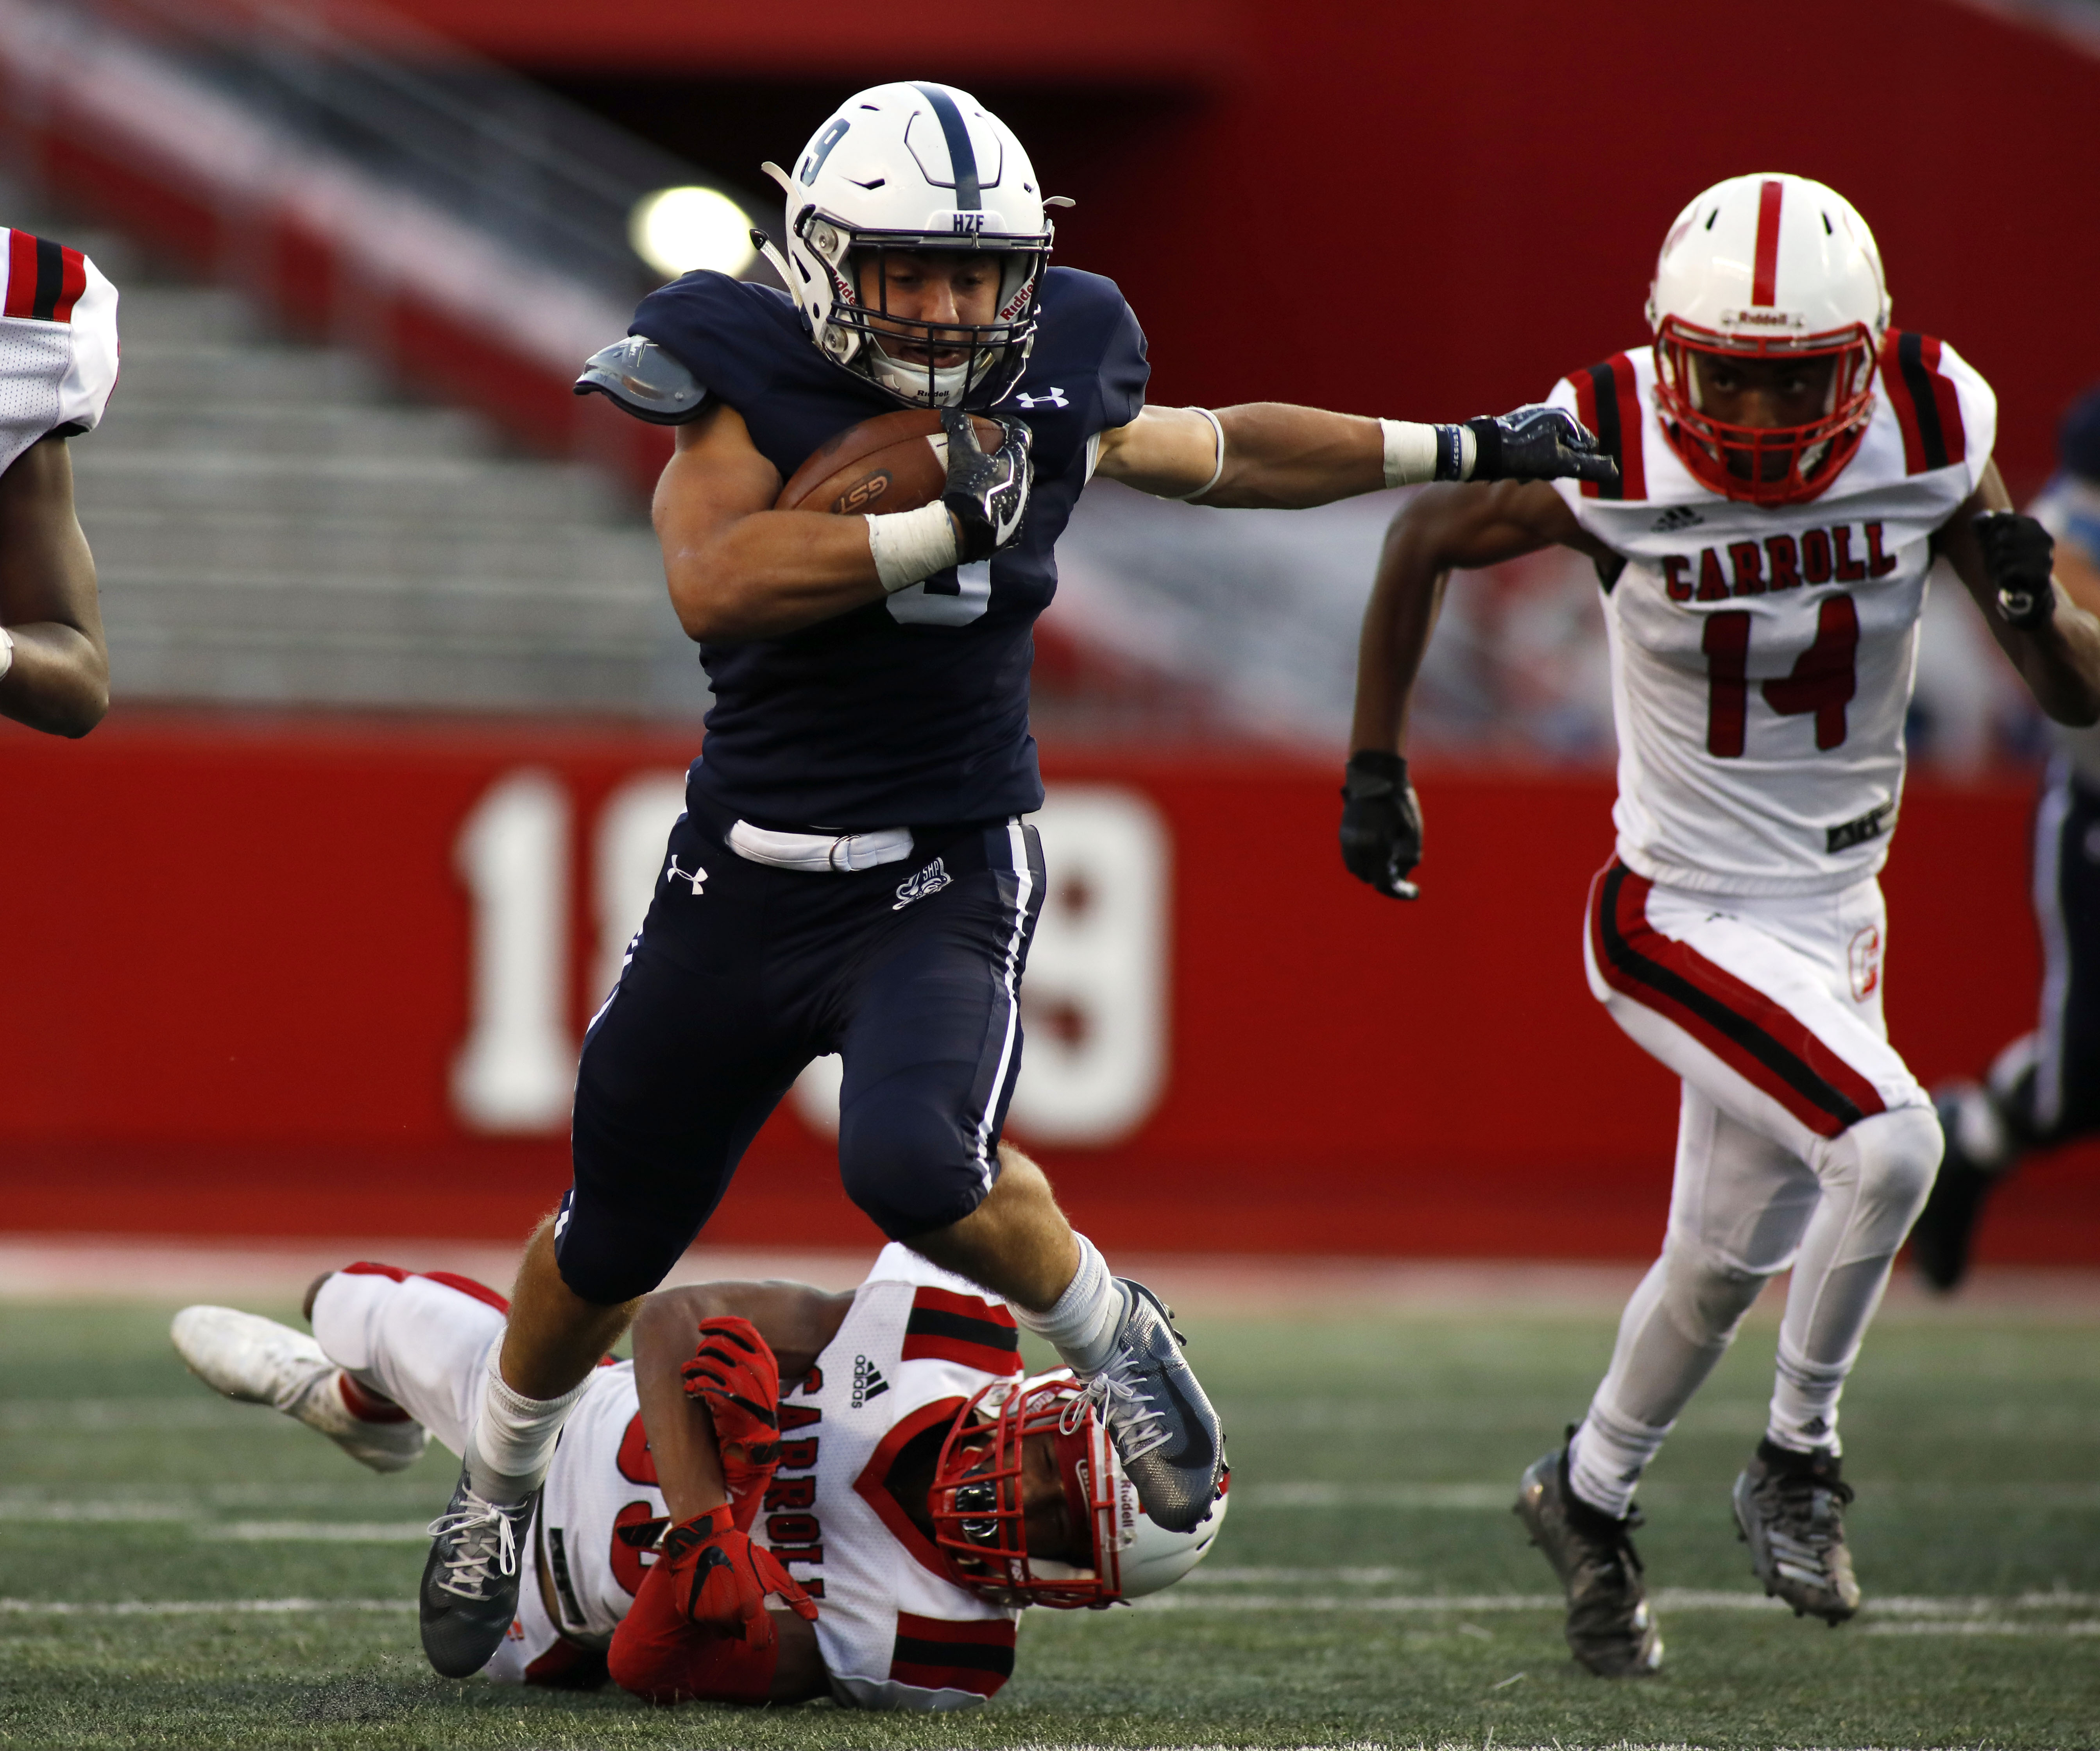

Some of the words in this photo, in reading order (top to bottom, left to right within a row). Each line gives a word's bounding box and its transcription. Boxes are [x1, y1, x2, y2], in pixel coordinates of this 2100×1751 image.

[800, 118, 850, 187] 9
[953, 214, 984, 232] HZF
[1000, 277, 1035, 321] Ridde
[1662, 522, 1897, 601] CARROLL
[1702, 593, 1860, 758] 14
[922, 861, 939, 881] SHP
[851, 1354, 867, 1409] adidas
